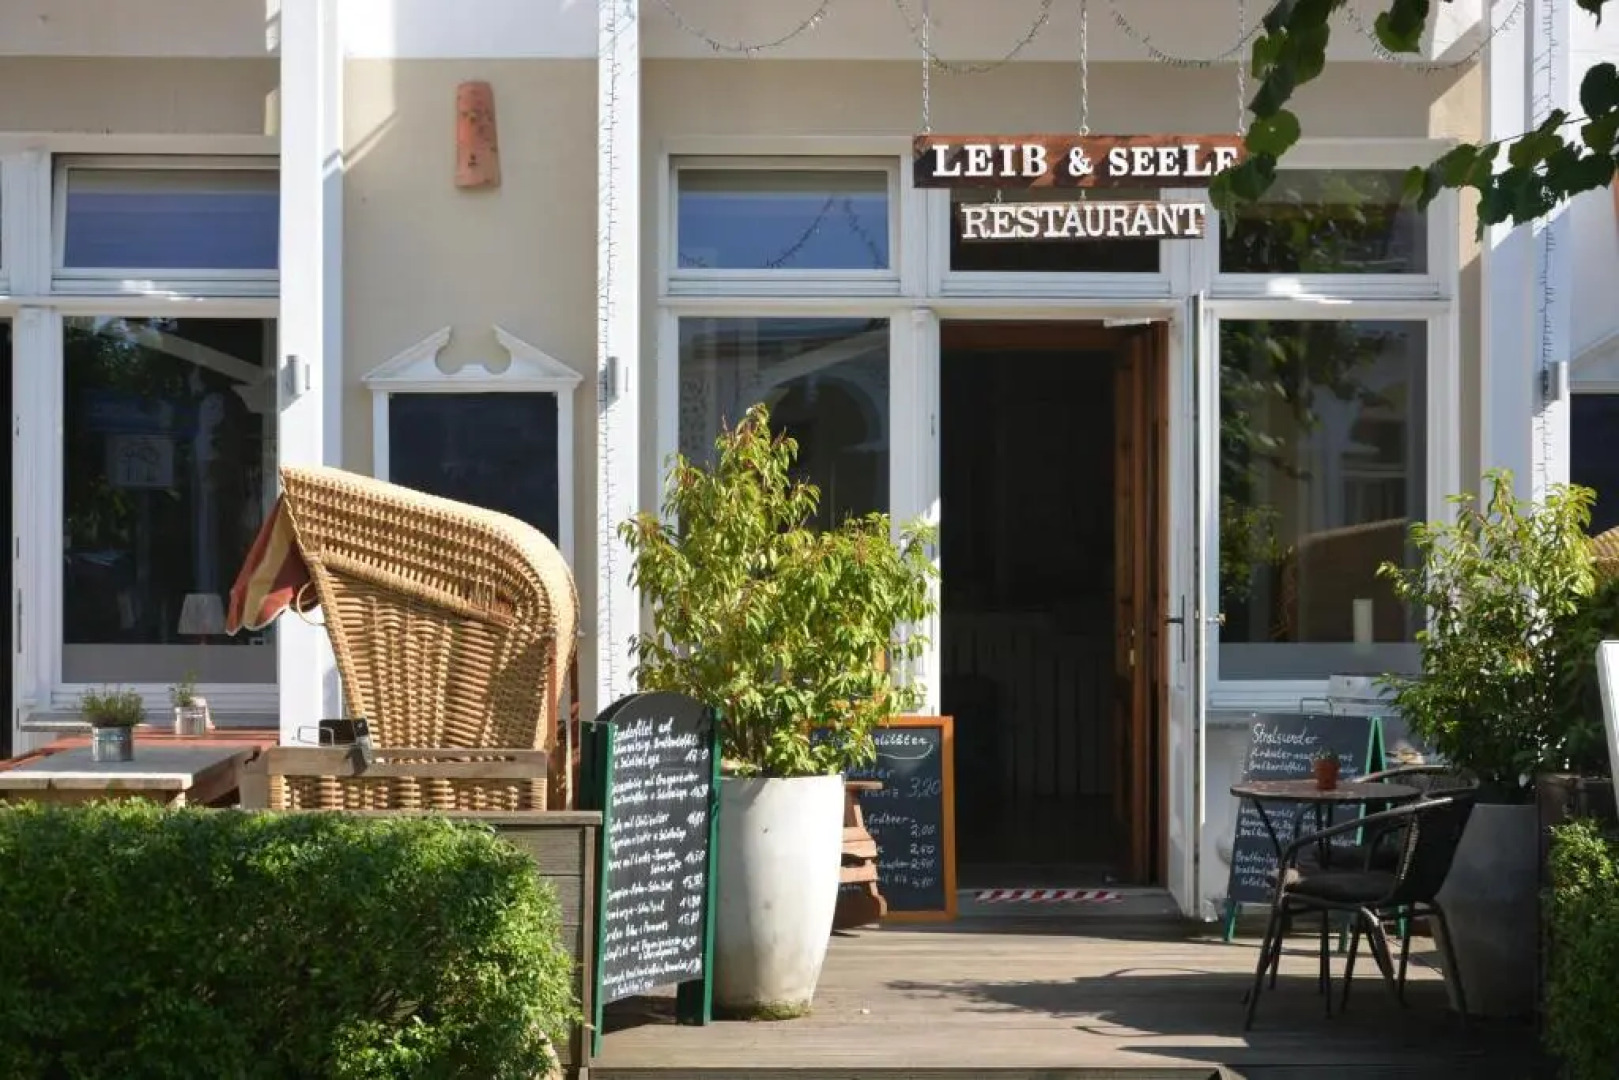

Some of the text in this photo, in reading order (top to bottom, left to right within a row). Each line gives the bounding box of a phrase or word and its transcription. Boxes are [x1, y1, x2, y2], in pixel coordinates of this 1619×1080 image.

[932, 144, 1048, 177] LEIB
[1068, 146, 1093, 175] &
[961, 203, 1205, 239] RESTAURANT
